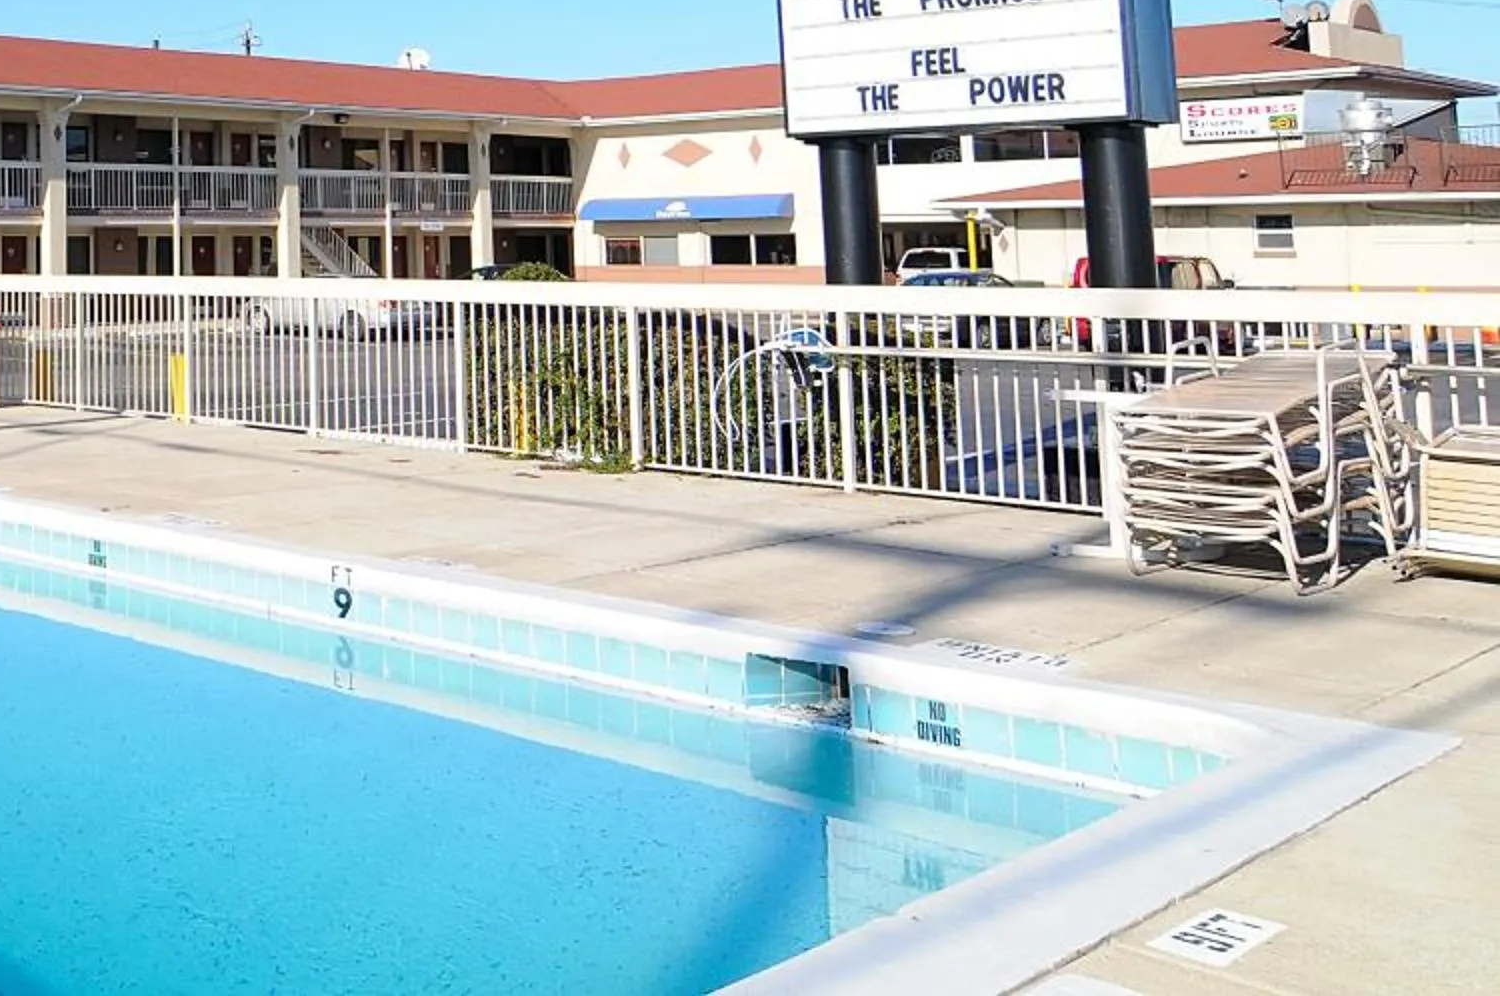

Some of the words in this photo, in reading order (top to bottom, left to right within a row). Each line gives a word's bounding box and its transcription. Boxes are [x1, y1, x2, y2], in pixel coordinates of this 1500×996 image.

[911, 47, 965, 76] FEEL
[857, 84, 899, 112] THE
[969, 73, 1066, 105] POWER
[331, 565, 353, 587] FT
[333, 587, 352, 618] 9
[929, 700, 946, 722] NO
[917, 720, 962, 747] DIVING
